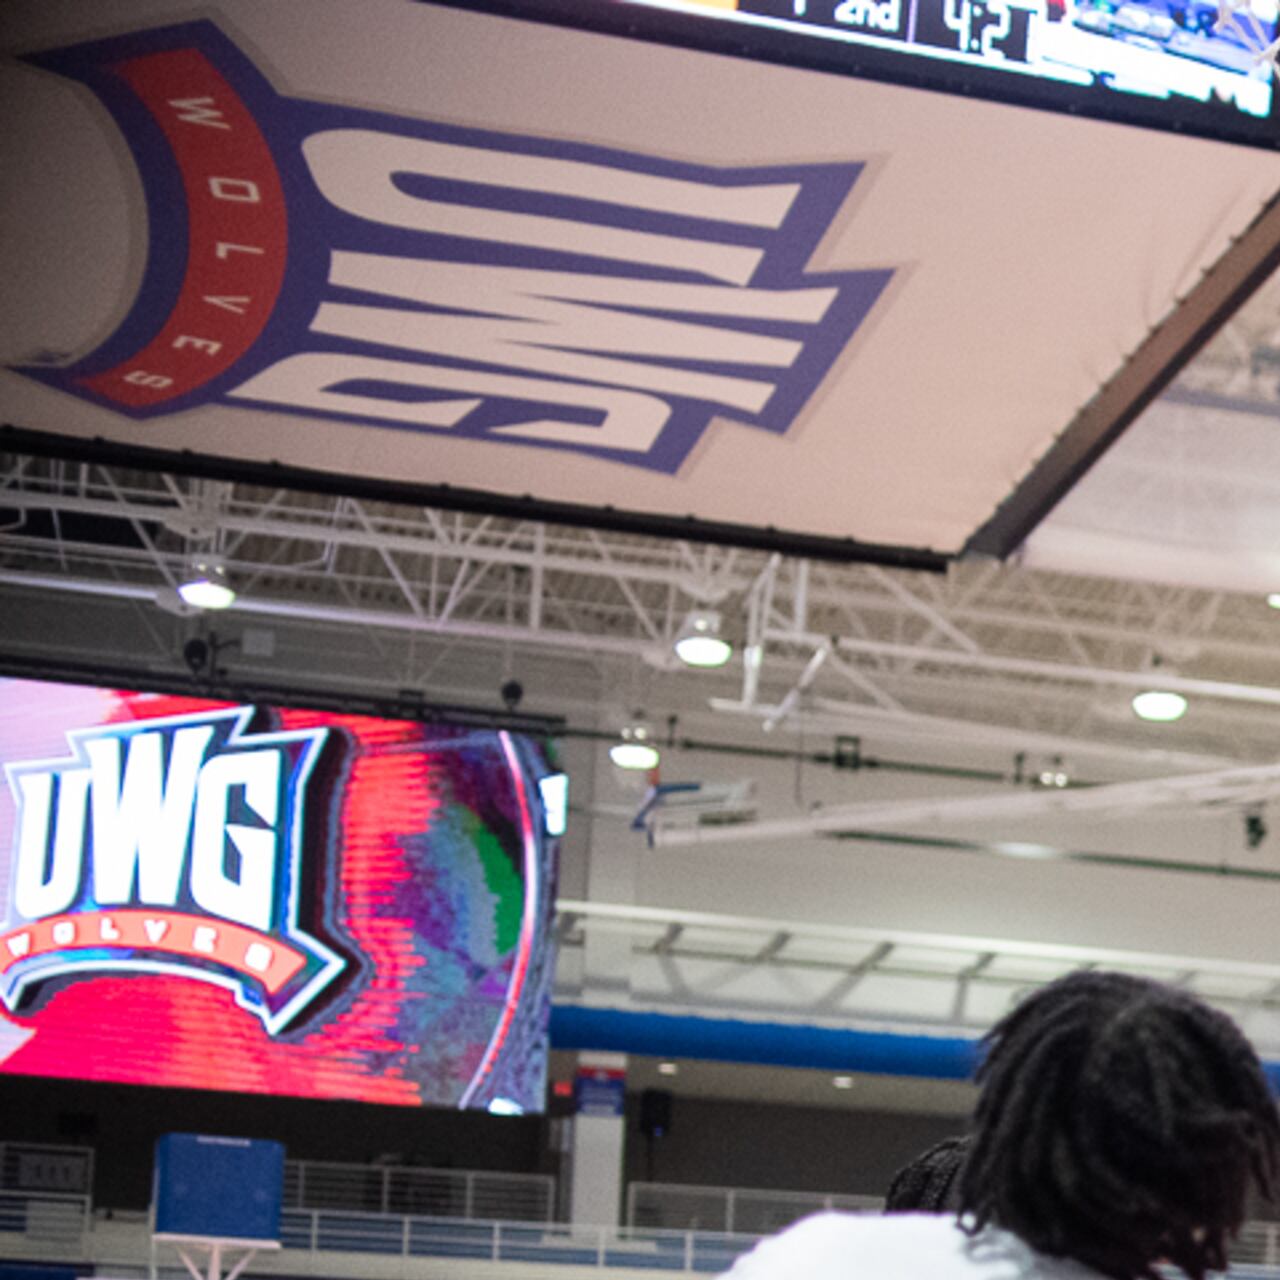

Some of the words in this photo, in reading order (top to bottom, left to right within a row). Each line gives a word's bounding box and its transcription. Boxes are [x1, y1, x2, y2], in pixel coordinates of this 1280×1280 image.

[123, 96, 264, 390] WOLVES
[226, 129, 840, 452] UWG
[6, 918, 275, 972] WOLVES
[12, 724, 281, 932] UWG
